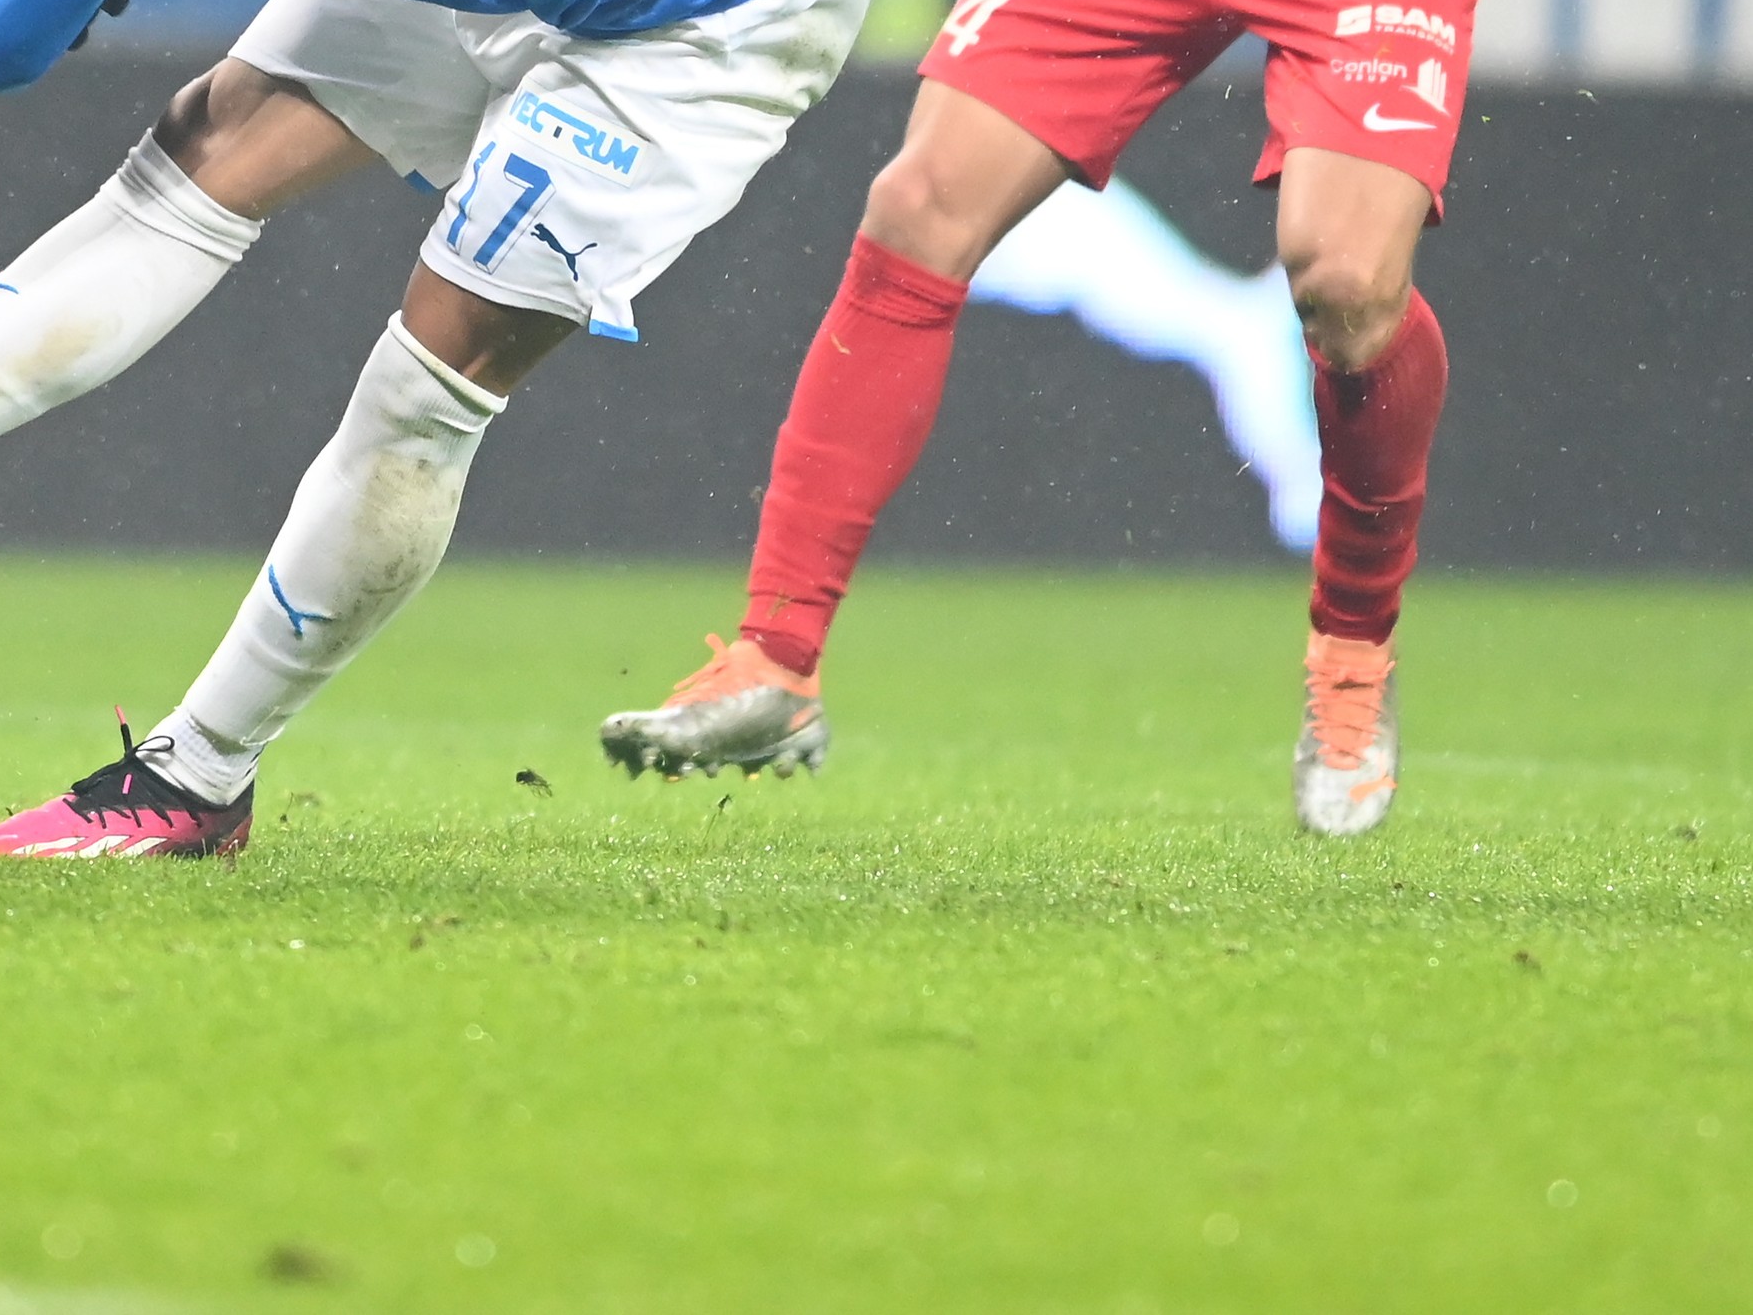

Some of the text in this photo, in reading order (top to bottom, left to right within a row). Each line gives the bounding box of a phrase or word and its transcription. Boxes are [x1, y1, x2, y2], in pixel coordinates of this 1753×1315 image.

[1374, 4, 1456, 46] SAM
[1374, 24, 1455, 56] TRANSPORT
[508, 85, 641, 175] VECTRUM
[446, 140, 557, 276] 17
